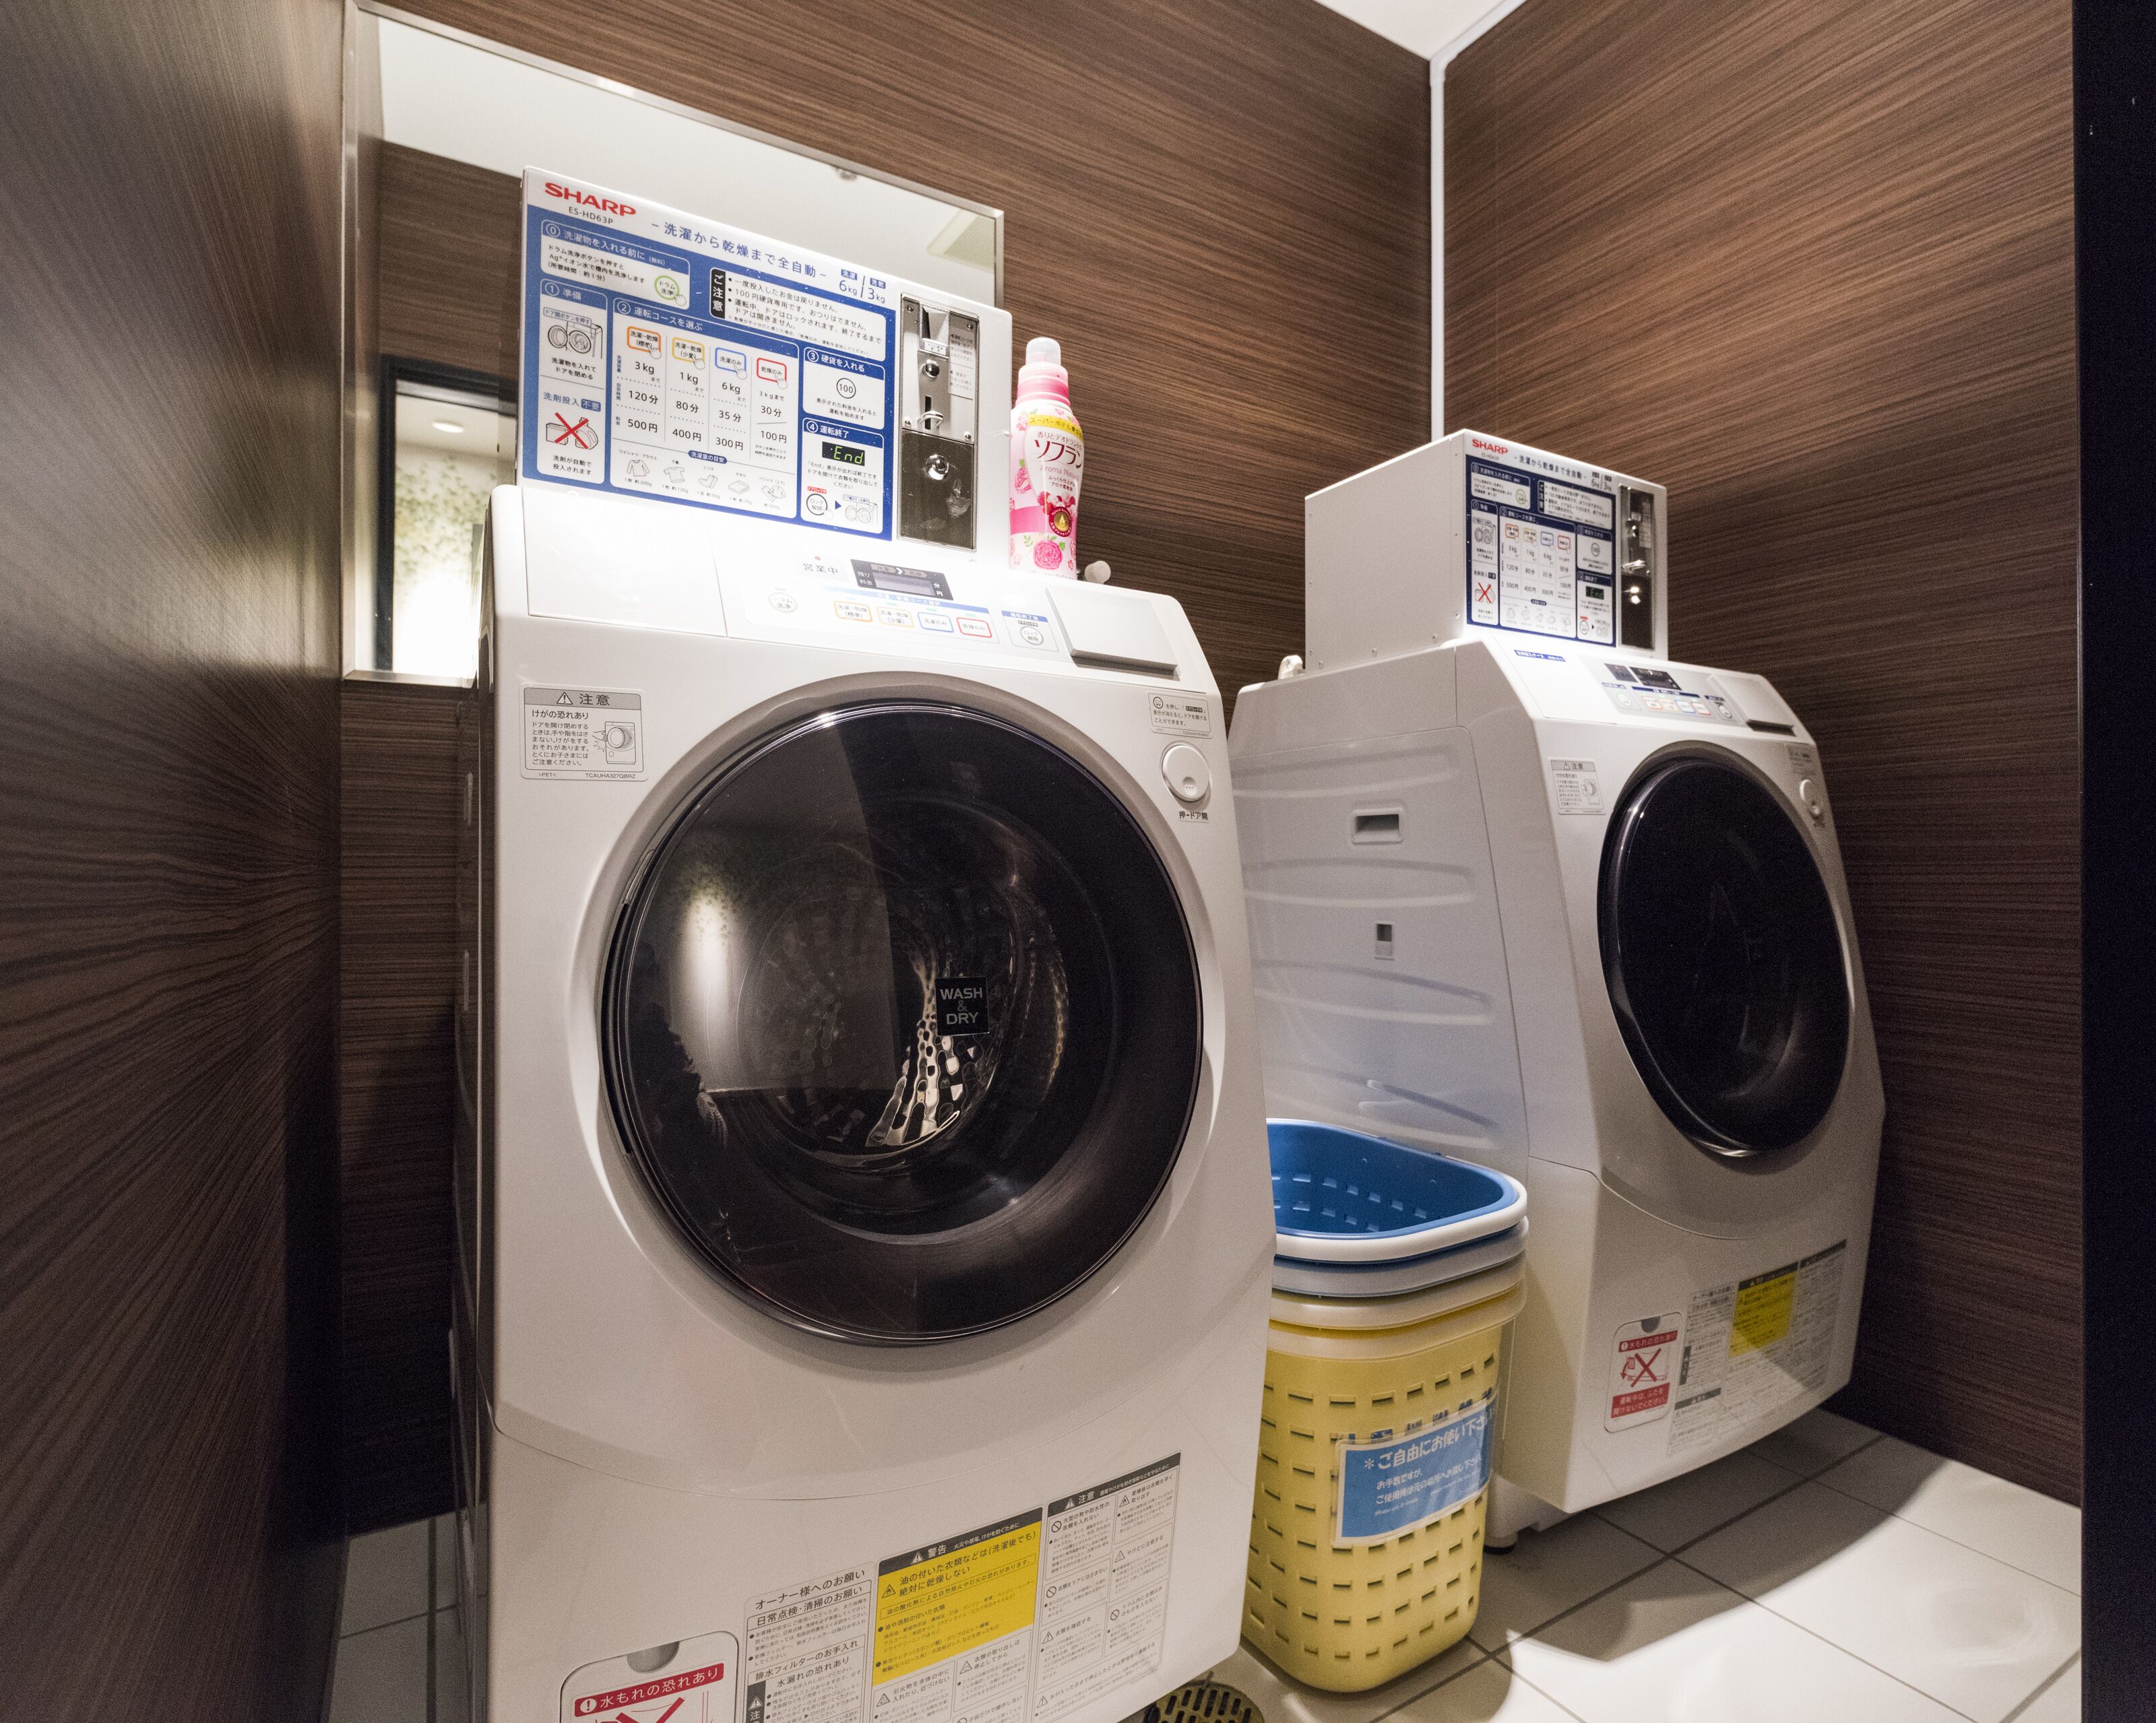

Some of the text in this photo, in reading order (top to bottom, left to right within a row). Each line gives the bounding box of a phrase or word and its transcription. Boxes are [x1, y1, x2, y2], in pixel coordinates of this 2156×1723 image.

[545, 182, 637, 216] SHARP
[569, 206, 614, 225] ES-HD63P
[564, 230, 645, 260] 洗濯物を入れる前に
[563, 289, 581, 300] 準備
[713, 274, 724, 313] ご注意
[633, 306, 703, 331] 運転コースを選ぶ
[821, 354, 864, 372] 硬貨を入れる
[839, 383, 853, 394] 100
[544, 392, 579, 407] 洗剤投入
[820, 425, 849, 438] 運転終了
[833, 445, 864, 465] End
[1034, 440, 1082, 468] ソフラン
[1472, 439, 1509, 455] SHARP
[691, 451, 725, 464] 洗濯量の目安
[579, 693, 610, 706] 注意
[532, 709, 589, 719] けがの恐れあり
[532, 721, 589, 729] ドアを開け閉めする
[940, 987, 983, 1000] WASH
[957, 1000, 968, 1012] &
[946, 1012, 979, 1025] DRY
[1078, 1491, 1095, 1505] 注意
[928, 1544, 947, 1559] 警告
[755, 1569, 865, 1611] オーナー様へのお願い
[899, 1566, 970, 1597] 絶対に乾燥しない
[757, 1586, 862, 1627] 日常点検・清掃のお願い
[755, 1640, 858, 1681] 排水フィルターのお手入れ
[777, 1656, 849, 1688] 水漏れの恐れあり
[600, 1667, 718, 1708] 水もれの恐れあり
